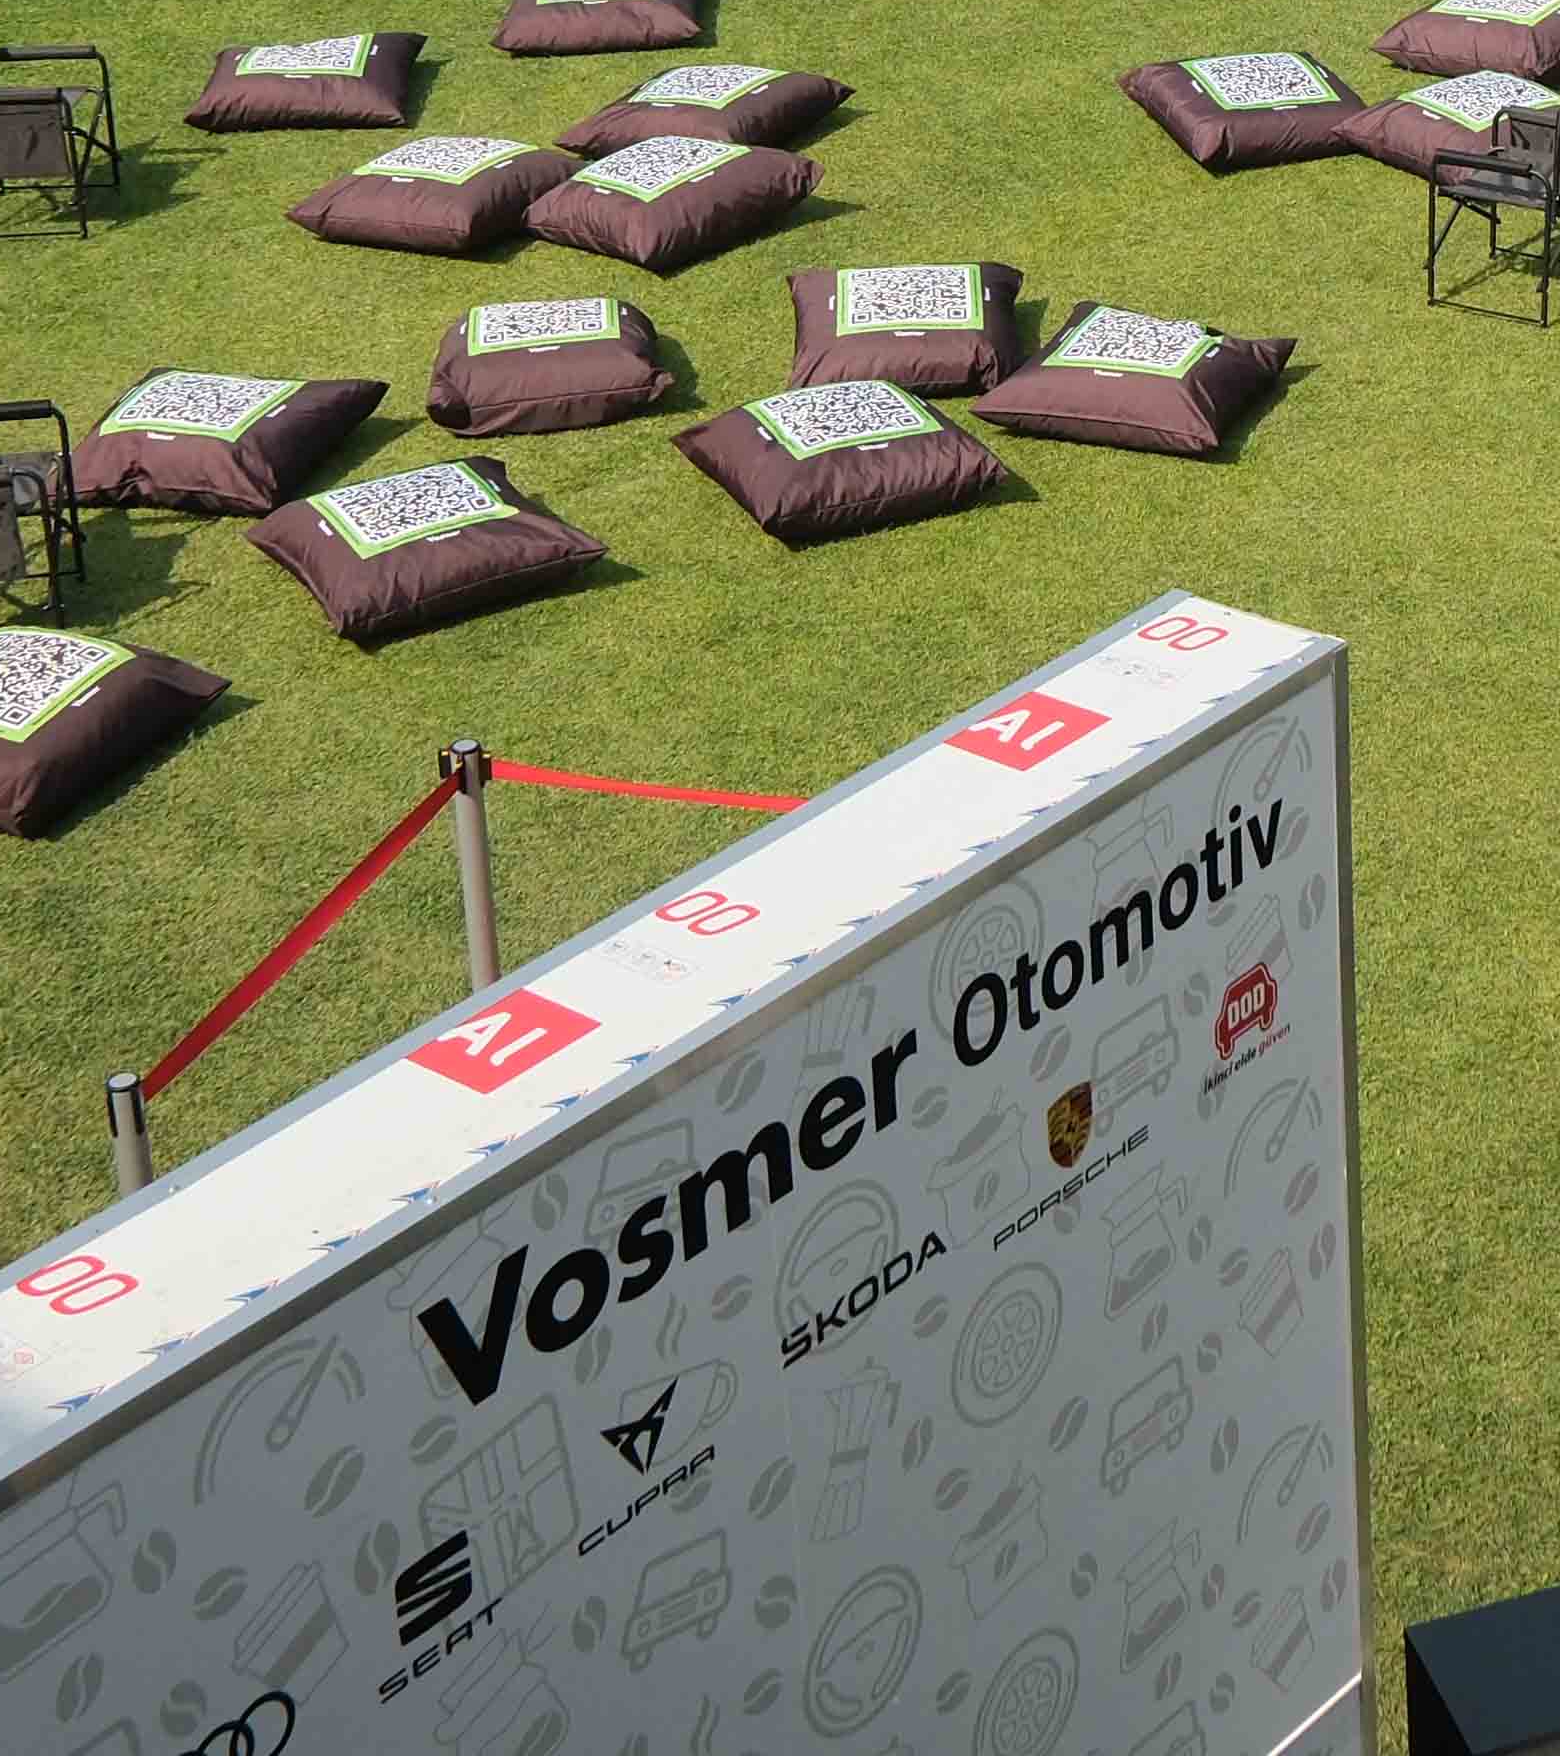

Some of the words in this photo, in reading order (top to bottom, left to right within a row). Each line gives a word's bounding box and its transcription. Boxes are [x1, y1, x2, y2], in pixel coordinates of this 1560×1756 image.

[416, 1027, 918, 1407] Vosmer
[952, 798, 1283, 1067] Otomotiv
[993, 1124, 1149, 1252] PORSCHE
[577, 1443, 716, 1558] CUPRA
[379, 1597, 503, 1705] SEAT
